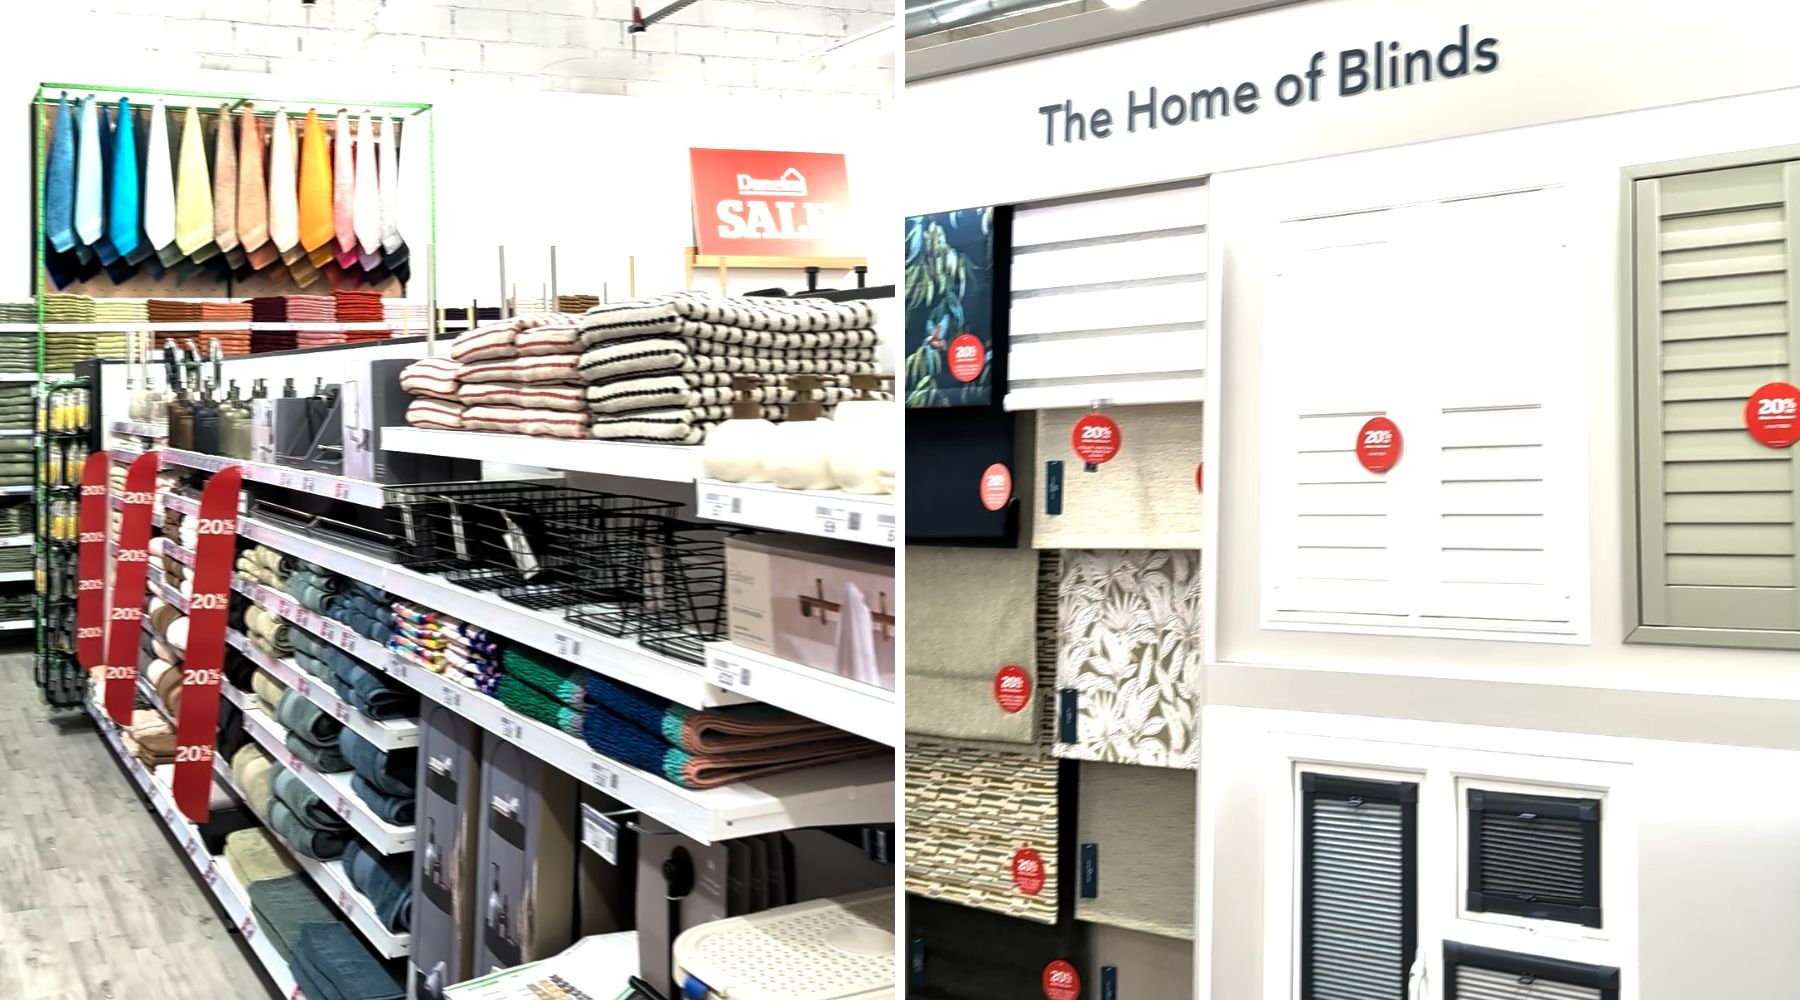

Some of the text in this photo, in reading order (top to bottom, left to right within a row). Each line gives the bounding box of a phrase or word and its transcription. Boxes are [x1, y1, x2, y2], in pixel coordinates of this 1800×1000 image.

[1039, 24, 1499, 146] The Home of Blinds
[716, 199, 833, 239] SALE
[199, 519, 236, 535] 20%
[191, 593, 229, 609] 20%
[183, 668, 222, 685] 20%
[176, 745, 215, 761] 20%
